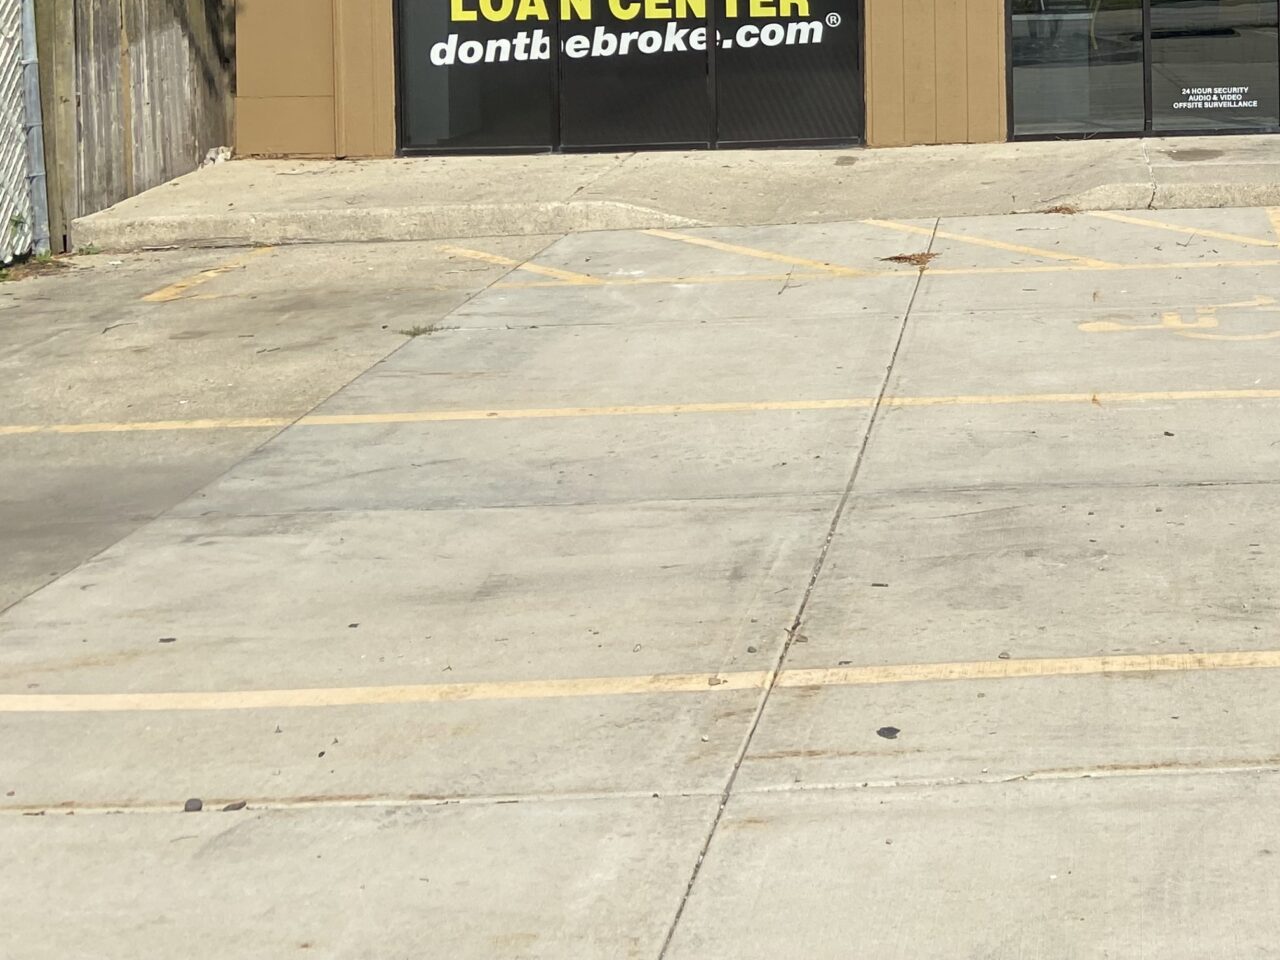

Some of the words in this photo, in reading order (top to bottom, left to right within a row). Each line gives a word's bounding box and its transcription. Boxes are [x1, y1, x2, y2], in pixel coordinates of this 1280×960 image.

[1191, 87, 1213, 95] HOUR
[1213, 86, 1249, 94] SECURITY
[1219, 93, 1243, 101] VIDEO
[1173, 101, 1203, 109] OFFSITE
[1203, 100, 1258, 108] SURVEILLANCE
